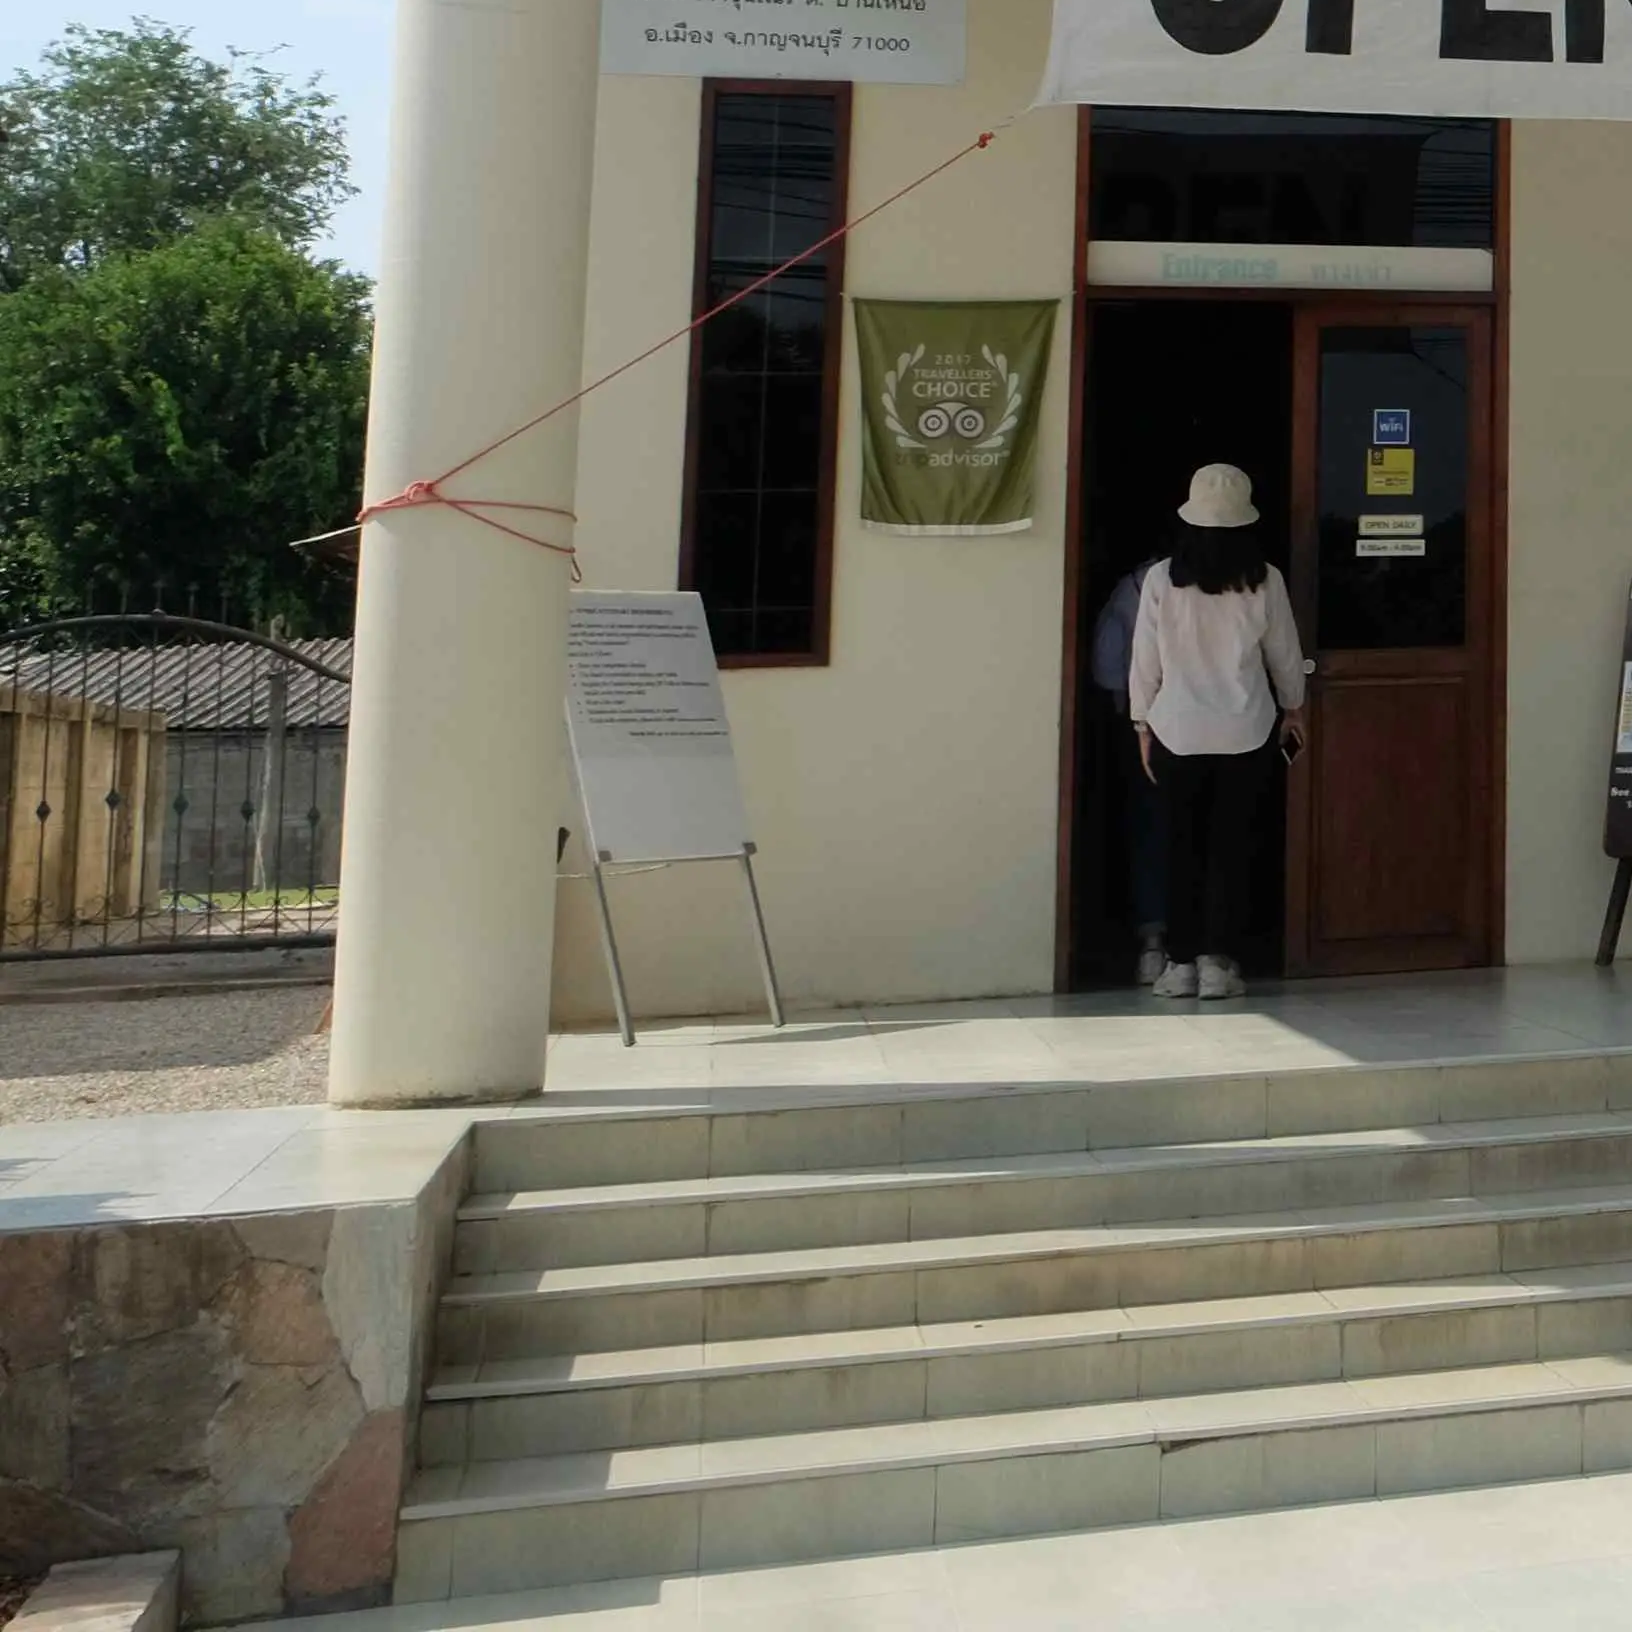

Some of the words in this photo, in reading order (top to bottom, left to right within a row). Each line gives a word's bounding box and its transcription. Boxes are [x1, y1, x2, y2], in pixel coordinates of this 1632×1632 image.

[852, 35, 910, 52] 71000
[1161, 253, 1279, 281] Entrance
[911, 381, 992, 399] CHOICE
